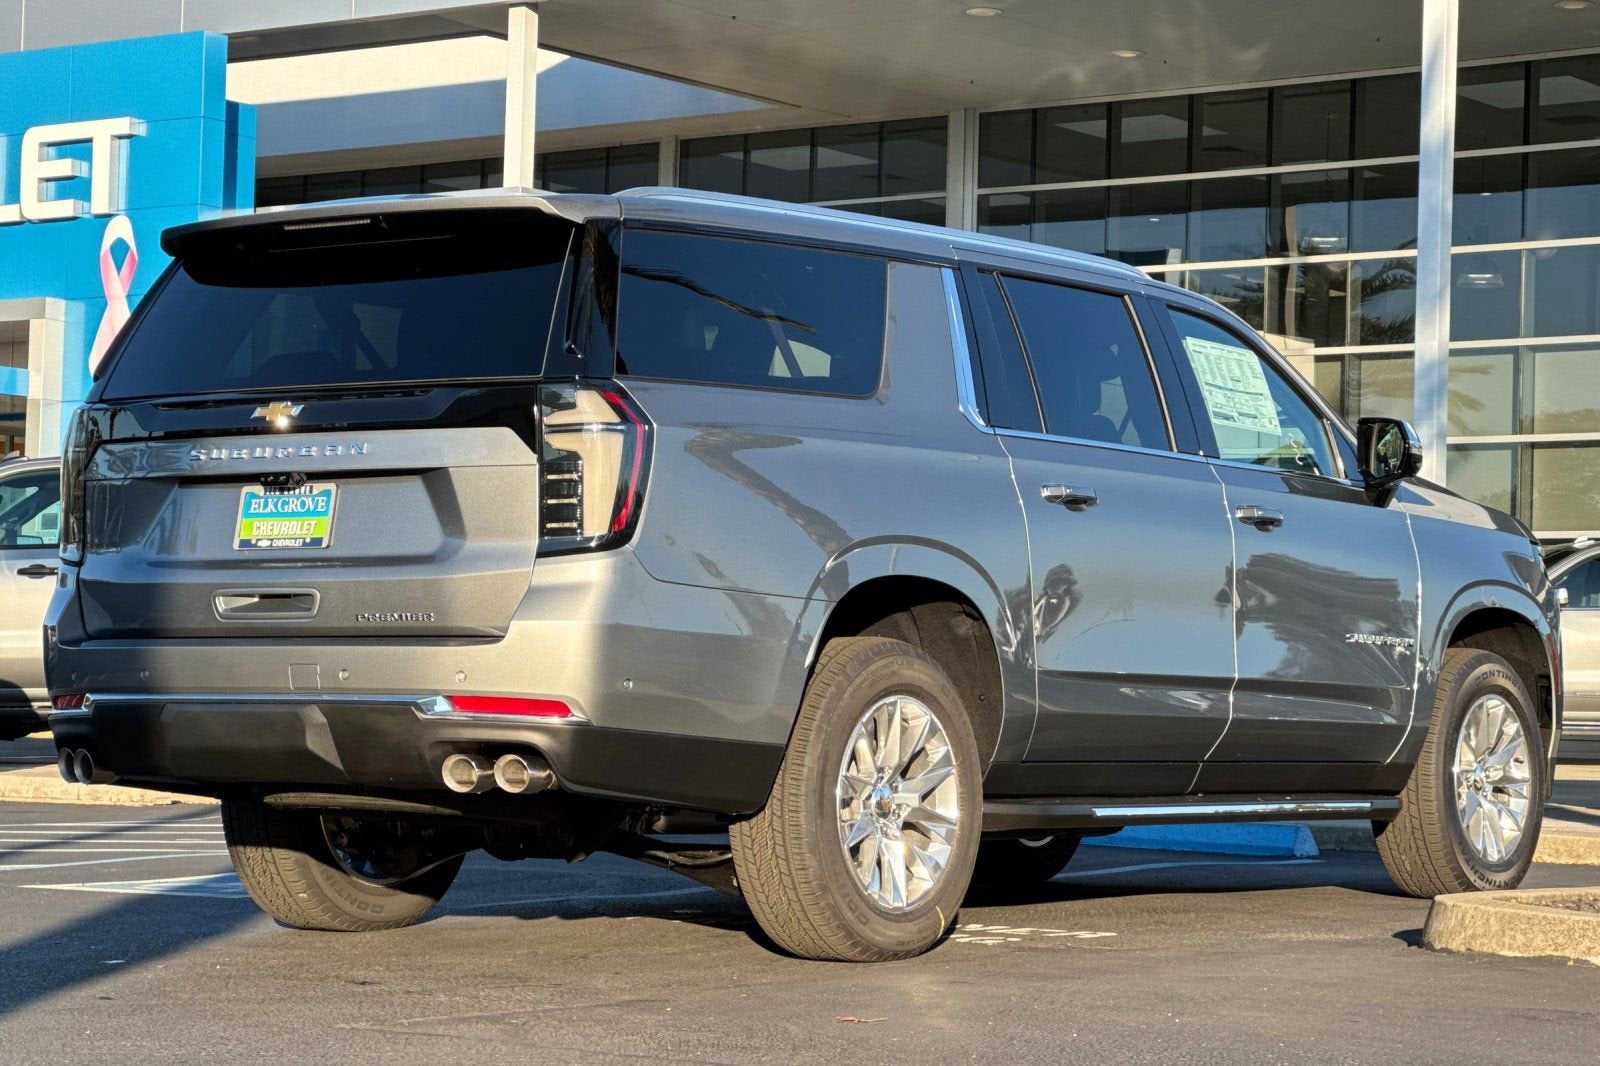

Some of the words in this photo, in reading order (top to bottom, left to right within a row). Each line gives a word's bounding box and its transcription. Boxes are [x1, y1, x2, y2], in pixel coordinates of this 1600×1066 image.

[189, 442, 368, 461] SUBURBAN
[248, 498, 276, 514] ELK
[277, 497, 327, 513] GROVE
[252, 520, 317, 537] CHEVROLET
[272, 539, 304, 547] CHEVROLET
[355, 612, 434, 622] PREMIER
